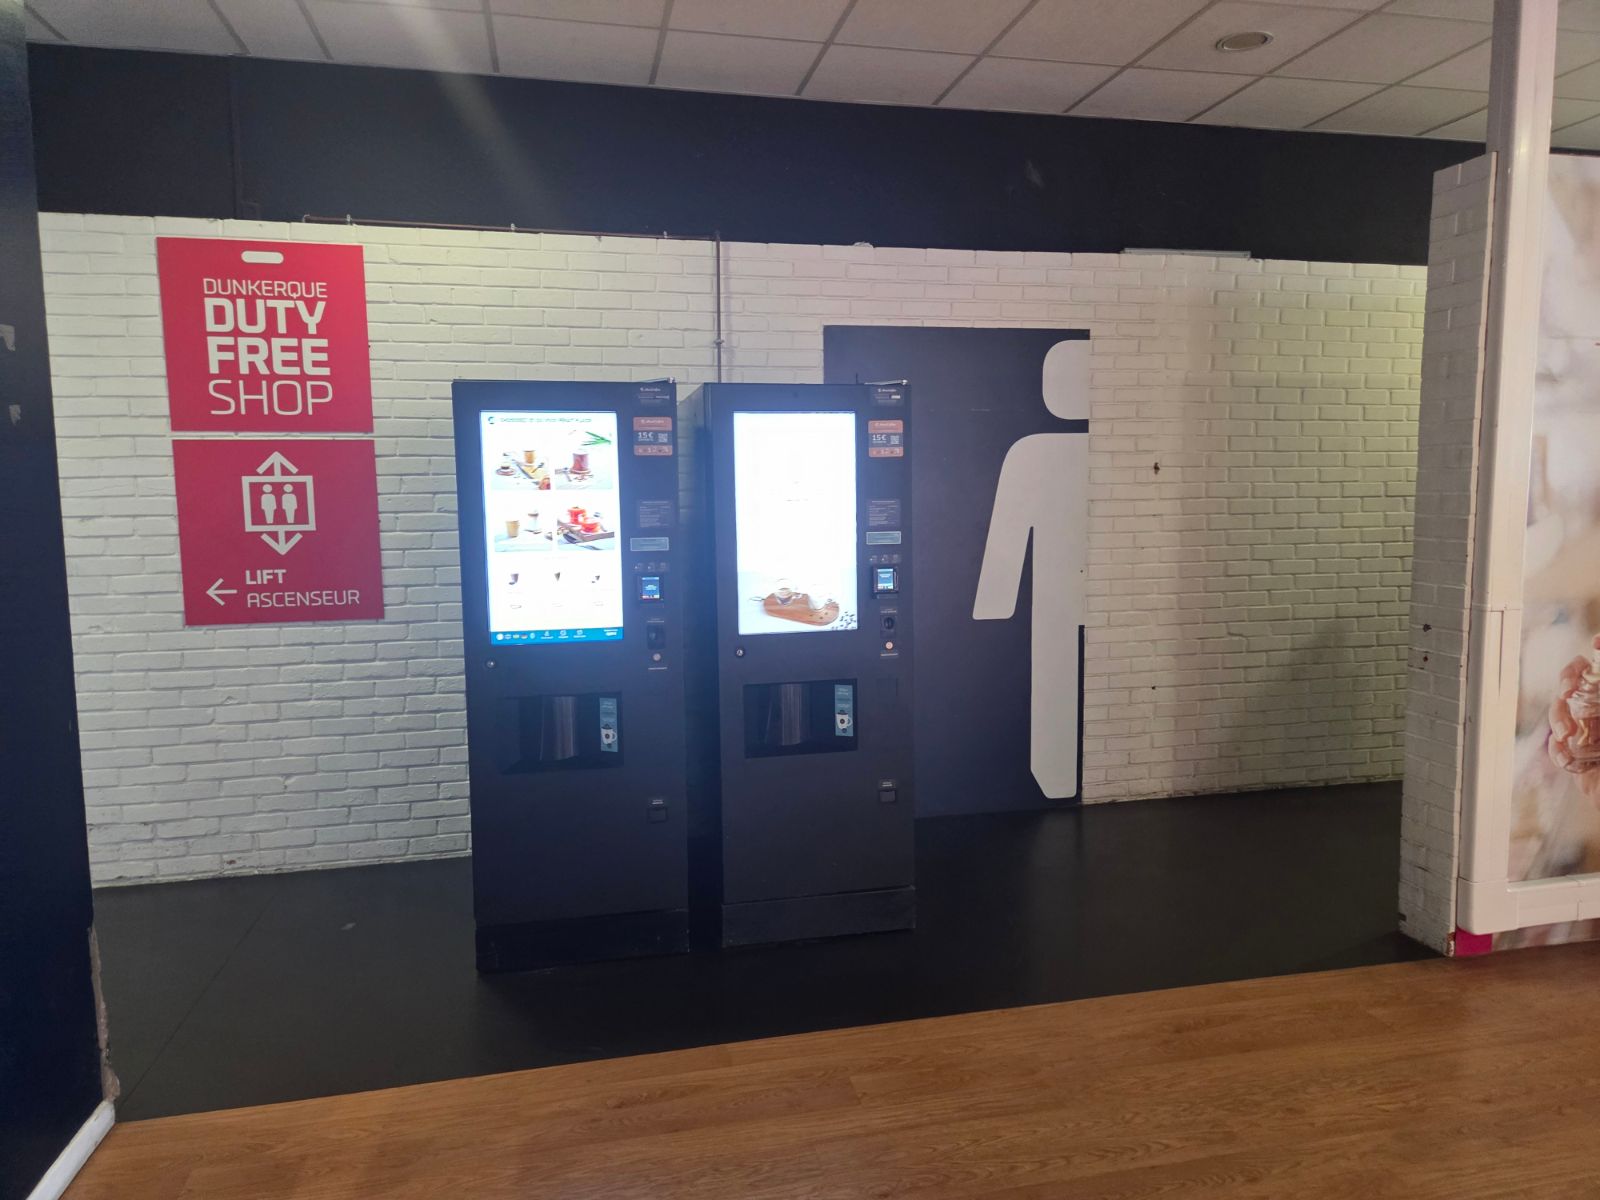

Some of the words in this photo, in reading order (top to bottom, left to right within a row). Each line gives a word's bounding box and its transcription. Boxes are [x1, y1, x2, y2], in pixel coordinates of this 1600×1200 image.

[203, 278, 328, 299] DUNKERQUE
[203, 297, 327, 335] DUTY
[206, 336, 331, 376] FREE
[208, 379, 333, 415] SHOP
[245, 569, 287, 585] LIFT
[247, 590, 361, 608] ASCENSEUR
